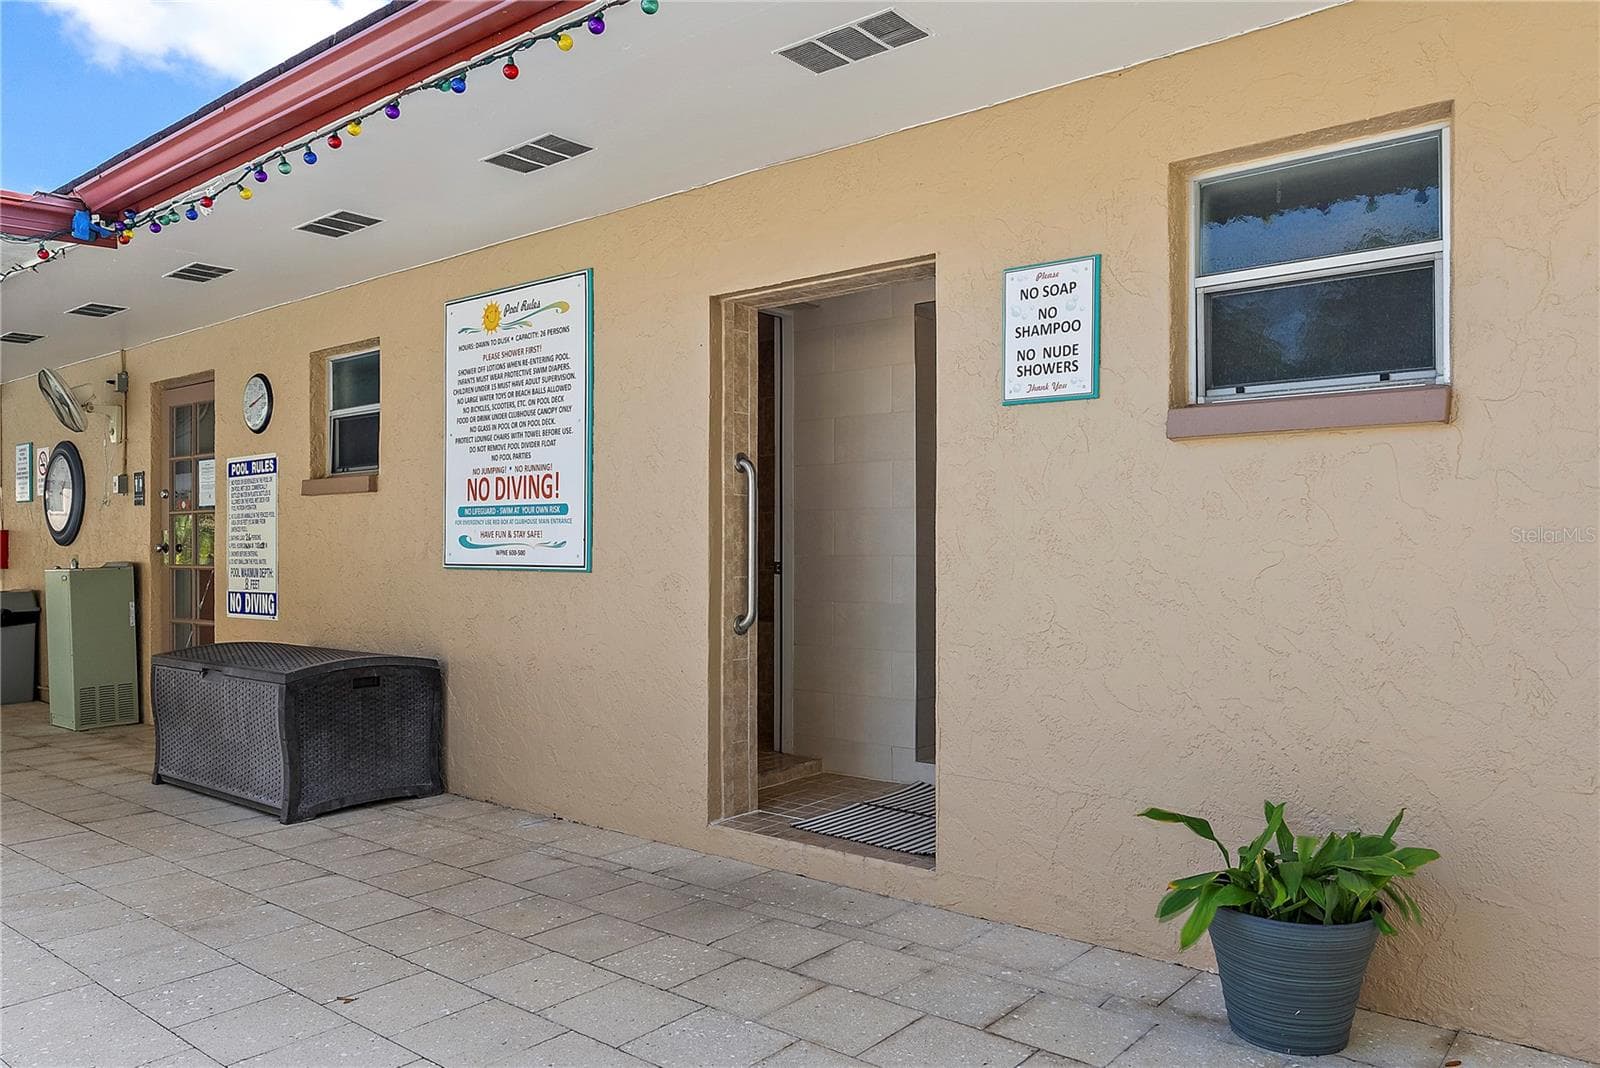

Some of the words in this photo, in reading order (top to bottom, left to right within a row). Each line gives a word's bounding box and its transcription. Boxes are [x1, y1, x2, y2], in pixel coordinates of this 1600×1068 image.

[1036, 272, 1059, 281] Please
[1020, 287, 1039, 300] NO
[1042, 282, 1077, 298] SOAP
[503, 302, 519, 317] Pool
[520, 299, 541, 313] Rules
[1038, 307, 1057, 320] NO
[1015, 320, 1081, 338] SHAMPOO
[458, 342, 475, 352] HOURS:
[476, 339, 489, 349] DAWN
[490, 338, 497, 346] TO
[497, 335, 510, 345] DUSK
[516, 330, 539, 341] CAPACITY:
[540, 329, 546, 337] 26
[547, 325, 570, 336] PERSONS
[483, 351, 500, 362] PLEASE
[501, 347, 524, 359] SHOWER
[525, 344, 542, 355] FIRST!
[1017, 349, 1035, 361] NO
[1043, 344, 1079, 359] NUDE
[458, 367, 477, 376] SHOWER
[478, 365, 486, 373] OFF
[487, 362, 505, 372] LOTIONS
[506, 360, 521, 369] WHEN
[522, 355, 554, 366] RE-ENTERING
[1017, 360, 1079, 377] SHOWERS
[457, 377, 475, 385] INFANTS
[476, 374, 489, 383] MUST
[490, 372, 503, 381] WEAR
[503, 368, 532, 379] PROTECTIVE
[533, 366, 547, 375] SWIM
[453, 386, 474, 396] CHILDREN
[475, 384, 490, 393] UNDER
[497, 381, 510, 389] MUST
[512, 379, 524, 388] HAVE
[525, 377, 540, 386] ADULT
[465, 395, 478, 403] LARGE
[479, 393, 494, 401] WATER
[515, 388, 531, 397] BEACH
[532, 386, 546, 395] BALLS
[547, 383, 571, 393] ALLOWED
[1027, 383, 1049, 393] Thank
[1052, 382, 1067, 391] You
[463, 406, 469, 414] NO
[528, 398, 535, 407] ON
[537, 396, 550, 406] POOL
[551, 395, 564, 404] DECK
[456, 416, 469, 424] FOOD
[469, 415, 476, 423] OR
[477, 414, 491, 422] DRINK
[491, 412, 507, 420] UNDER
[508, 409, 536, 418] CLUBHOUSE
[537, 406, 557, 415] CANOPY
[558, 405, 572, 413] ONLY
[478, 424, 491, 432] GLASS
[497, 422, 510, 430] POOL
[519, 420, 526, 428] ON
[527, 419, 540, 427] POOL
[455, 436, 474, 444] PROTECT
[475, 434, 493, 442] LOUNGE
[494, 432, 510, 440] CHAIRS
[511, 431, 523, 439] WITH
[524, 430, 541, 438] TOWEL
[542, 428, 561, 436] BEFORE
[487, 443, 506, 451] REMOVE
[507, 442, 520, 450] POOL
[521, 440, 540, 449] DIVIDER
[541, 439, 556, 447] FLOAT
[499, 453, 512, 461] POOL
[231, 462, 248, 475] POOL
[252, 460, 274, 473] RULES
[472, 467, 480, 475] NO
[481, 466, 507, 474] JUMPING!
[524, 463, 552, 472] RUNNING!
[467, 477, 490, 501] NO
[495, 472, 559, 500] DIVING!
[514, 506, 519, 514] AT
[549, 505, 560, 513] RISK
[480, 530, 494, 538] HAVE
[495, 530, 507, 538] FUN
[508, 530, 512, 538] &
[513, 530, 526, 538] STAY
[527, 530, 542, 538] SAFE!
[250, 580, 260, 589] FEET
[230, 593, 242, 612] NO
[245, 594, 275, 614] DIVING
